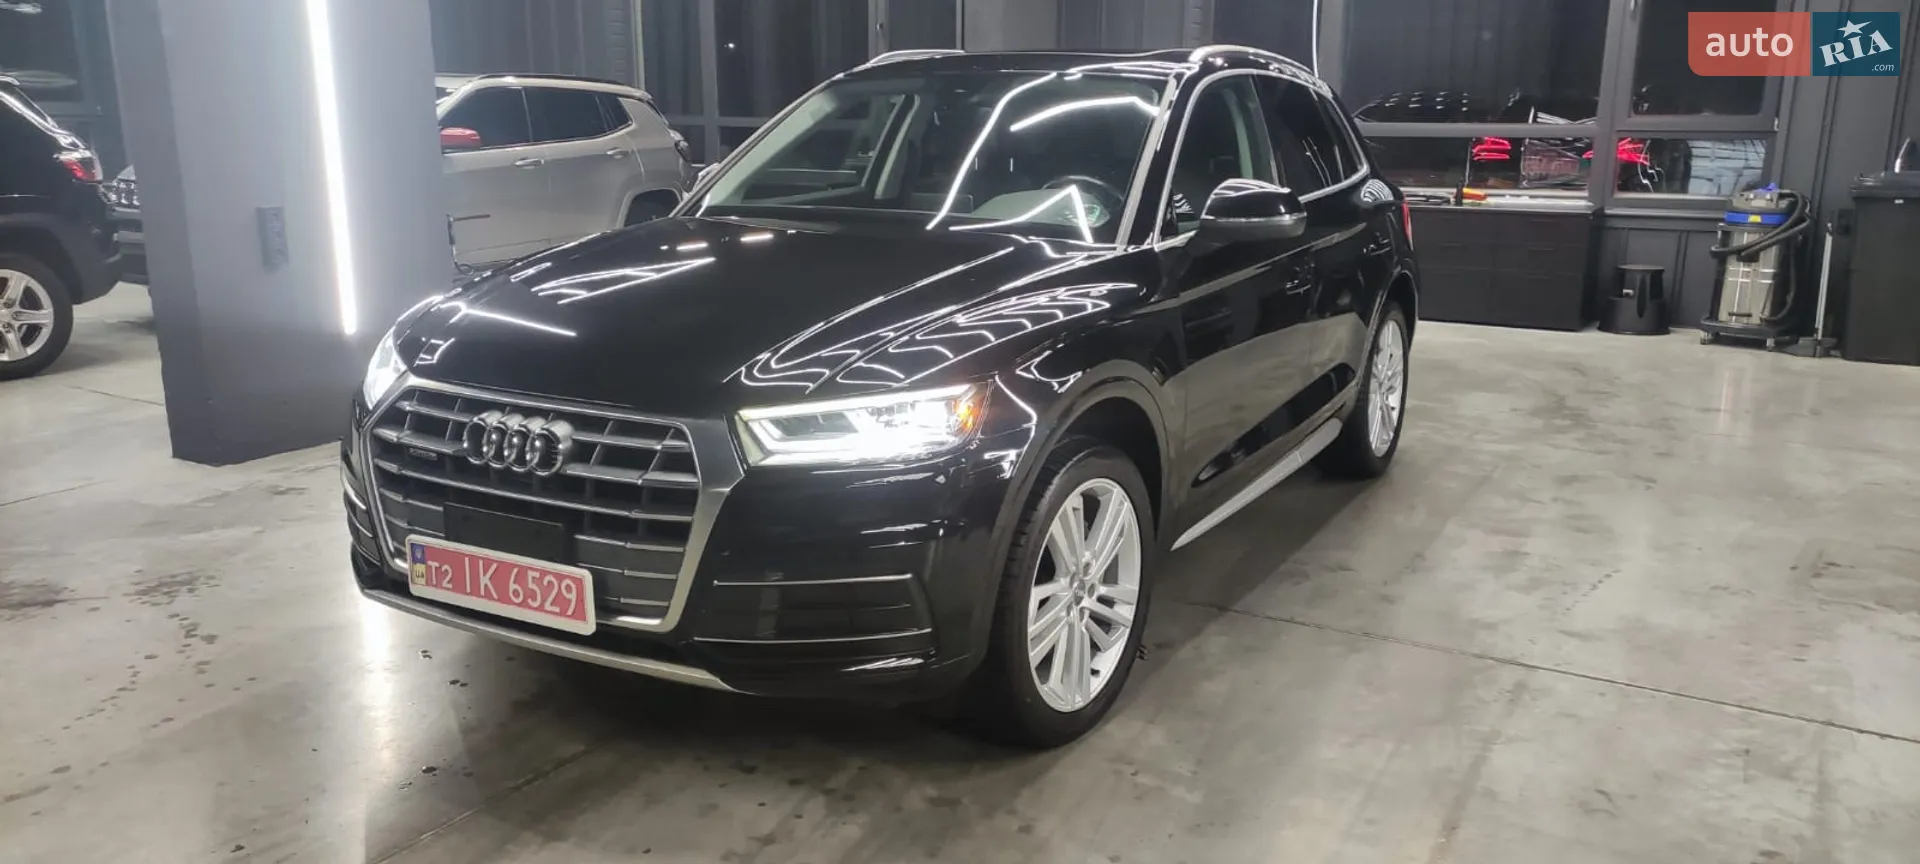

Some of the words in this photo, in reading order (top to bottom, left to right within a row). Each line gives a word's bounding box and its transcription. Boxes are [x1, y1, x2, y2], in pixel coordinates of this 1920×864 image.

[427, 560, 453, 589] T2
[464, 556, 499, 600] IK
[508, 567, 578, 616] 6529
